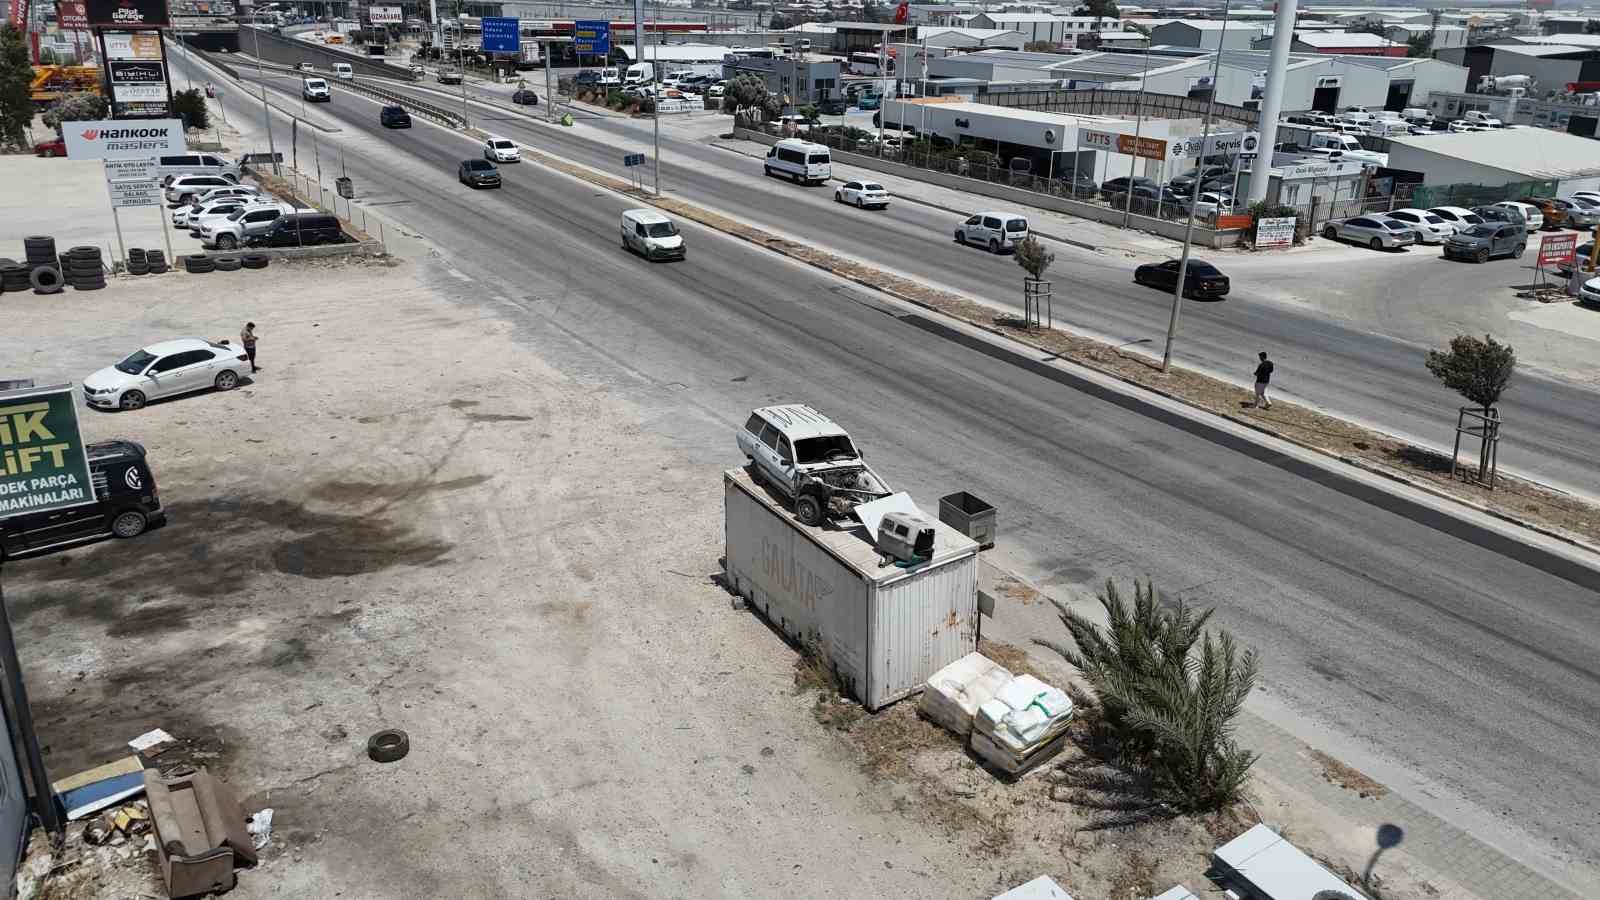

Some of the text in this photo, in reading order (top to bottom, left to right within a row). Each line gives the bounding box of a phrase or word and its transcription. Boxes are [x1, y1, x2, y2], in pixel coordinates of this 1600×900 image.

[1086, 132, 1111, 145] UTTS
[1215, 137, 1241, 150] Servis
[31, 473, 78, 490] PARÇA
